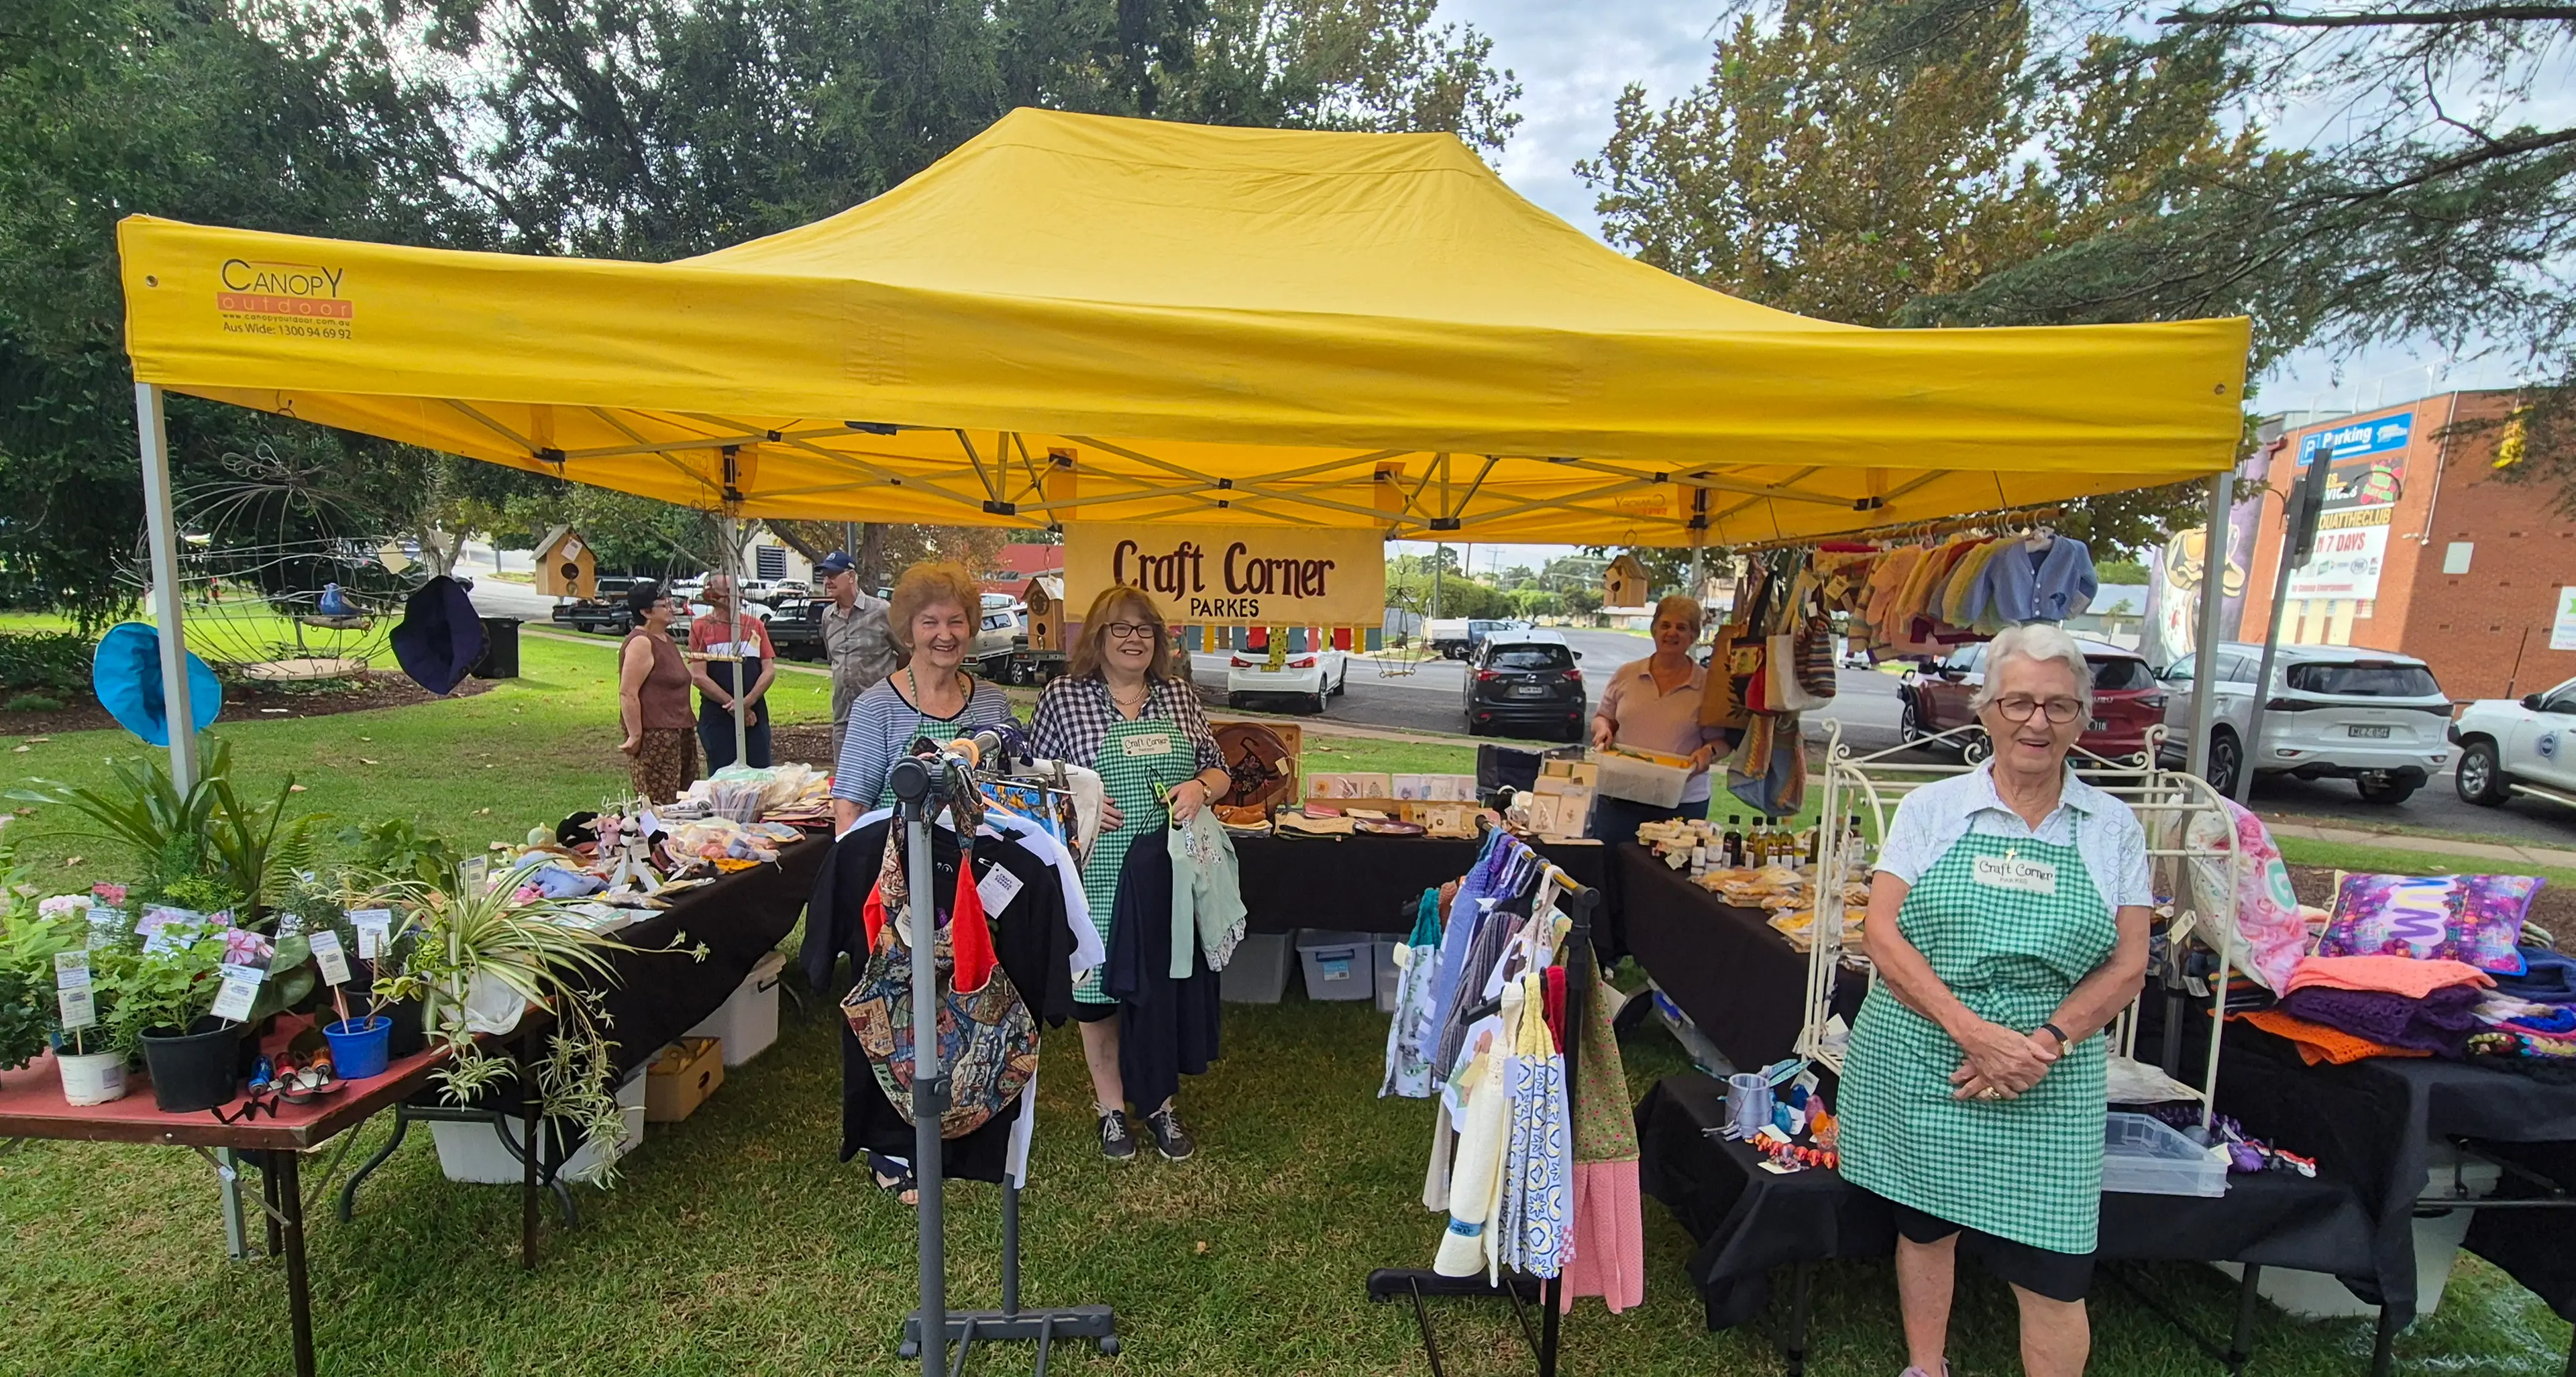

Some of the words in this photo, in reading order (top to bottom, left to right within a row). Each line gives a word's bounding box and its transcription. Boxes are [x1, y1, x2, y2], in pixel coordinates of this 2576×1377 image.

[222, 259, 343, 298] CANOPY
[223, 296, 346, 315] outdoor
[223, 321, 243, 333] Aus
[245, 324, 275, 334] Wide:
[279, 325, 305, 336] 1300
[307, 327, 320, 337] 94
[323, 329, 335, 338] 69
[338, 329, 352, 339] 92
[2336, 532, 2366, 552] DAYS
[1113, 539, 1205, 602] Craft
[1224, 541, 1335, 599] Corner
[1190, 598, 1260, 618] PARKES
[1125, 738, 1144, 749] Craft
[1980, 860, 2012, 876] Craft
[2016, 863, 2053, 881] Corner
